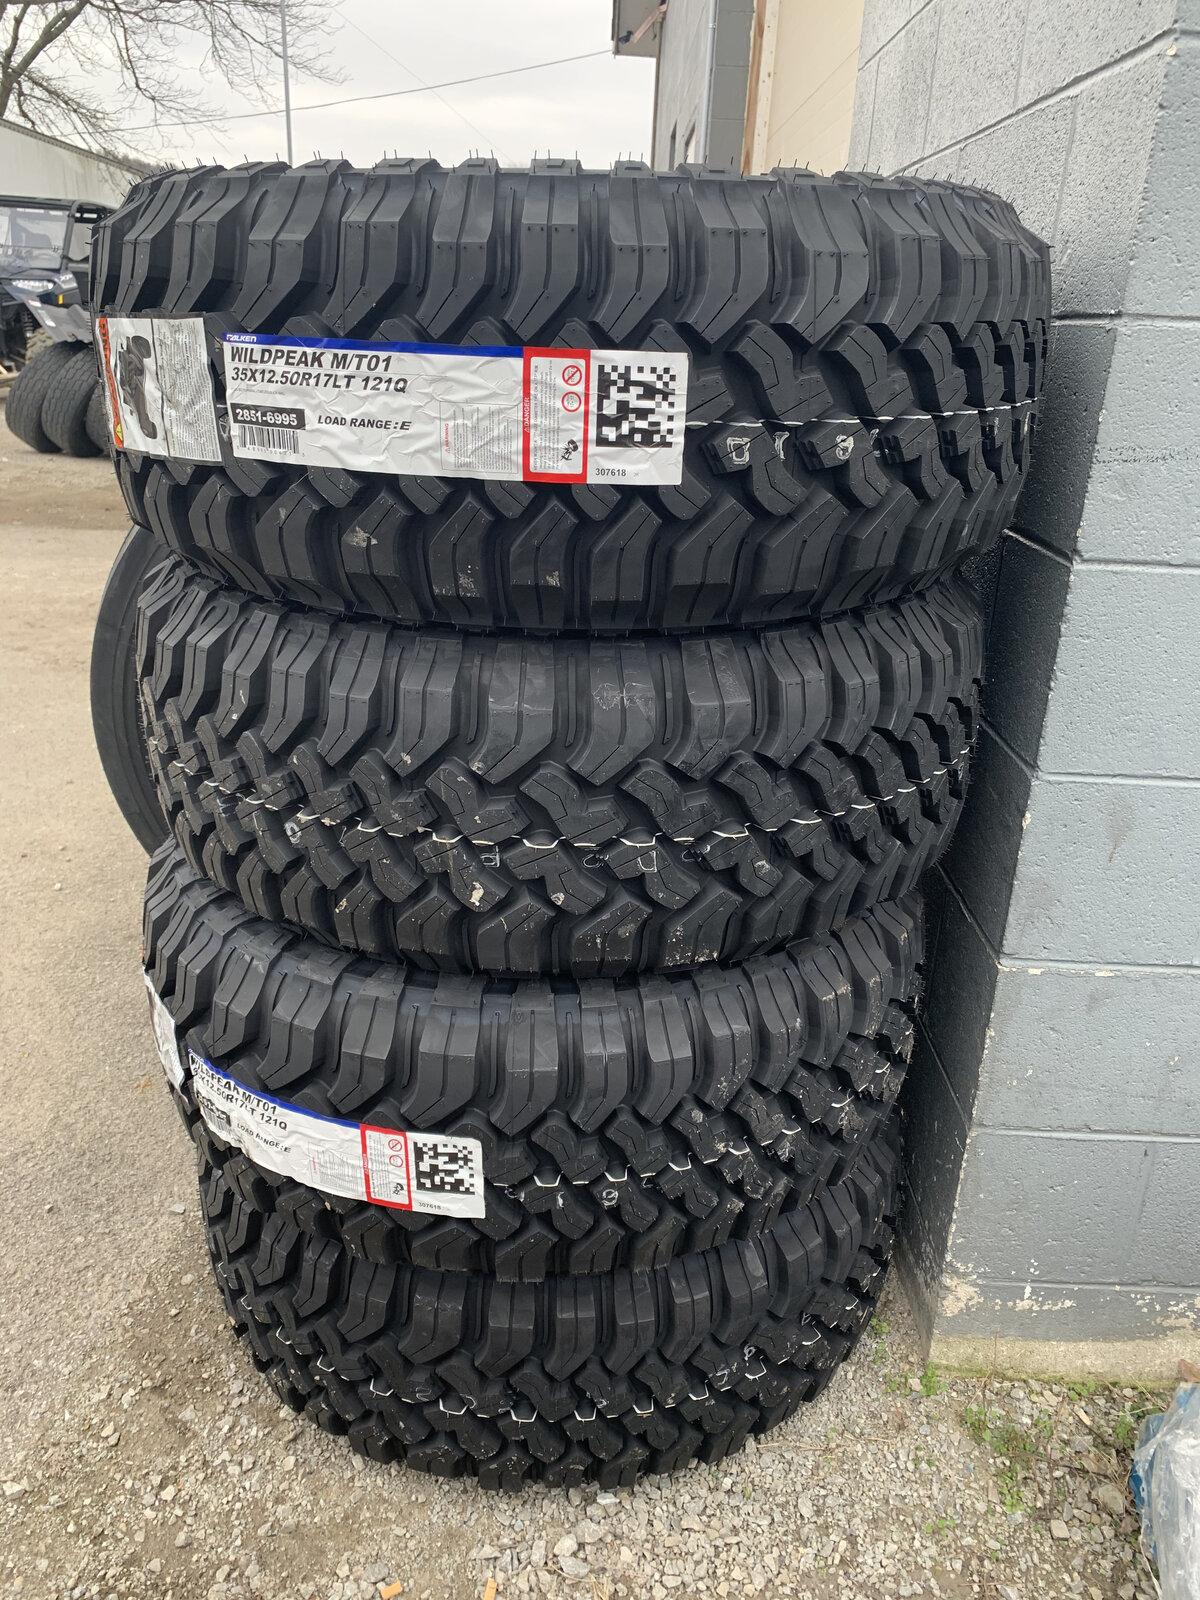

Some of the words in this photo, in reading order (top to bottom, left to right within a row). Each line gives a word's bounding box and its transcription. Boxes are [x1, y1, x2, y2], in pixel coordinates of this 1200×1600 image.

[226, 334, 257, 343] FALKEN
[231, 346, 325, 368] WILDPEAK
[331, 353, 392, 372] M/T01
[231, 367, 355, 389] 35X12.50R17LT
[361, 376, 408, 394] 121Q
[235, 408, 298, 426] 2851-6995
[318, 414, 347, 427] LOAD
[595, 468, 627, 477] 307618
[242, 1092, 277, 1115] M/T01
[237, 1122, 254, 1137] LOAD
[260, 1112, 288, 1131] 121Q
